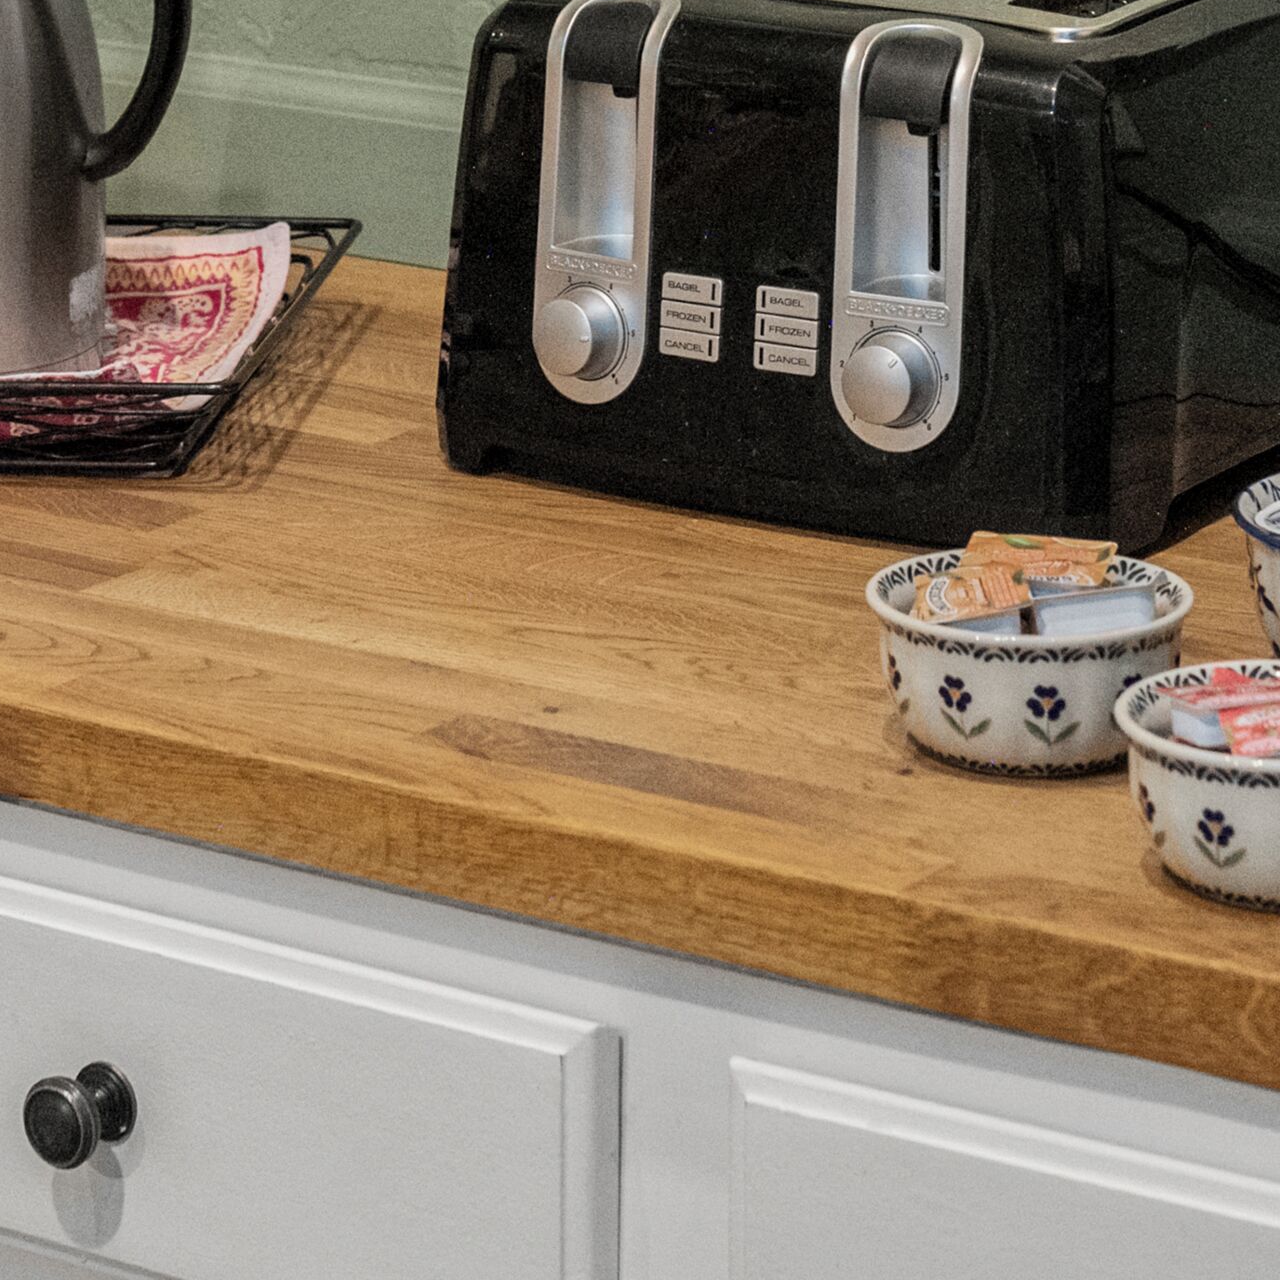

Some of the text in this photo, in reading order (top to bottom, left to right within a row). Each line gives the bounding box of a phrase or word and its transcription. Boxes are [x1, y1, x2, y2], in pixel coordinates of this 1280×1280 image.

[668, 280, 701, 294] BAGEL
[769, 295, 805, 309] BAGEL
[666, 309, 707, 325] FROZEN
[768, 324, 812, 339] FROZEN
[664, 339, 705, 354] CANCEL
[768, 353, 811, 368] CANCEL
